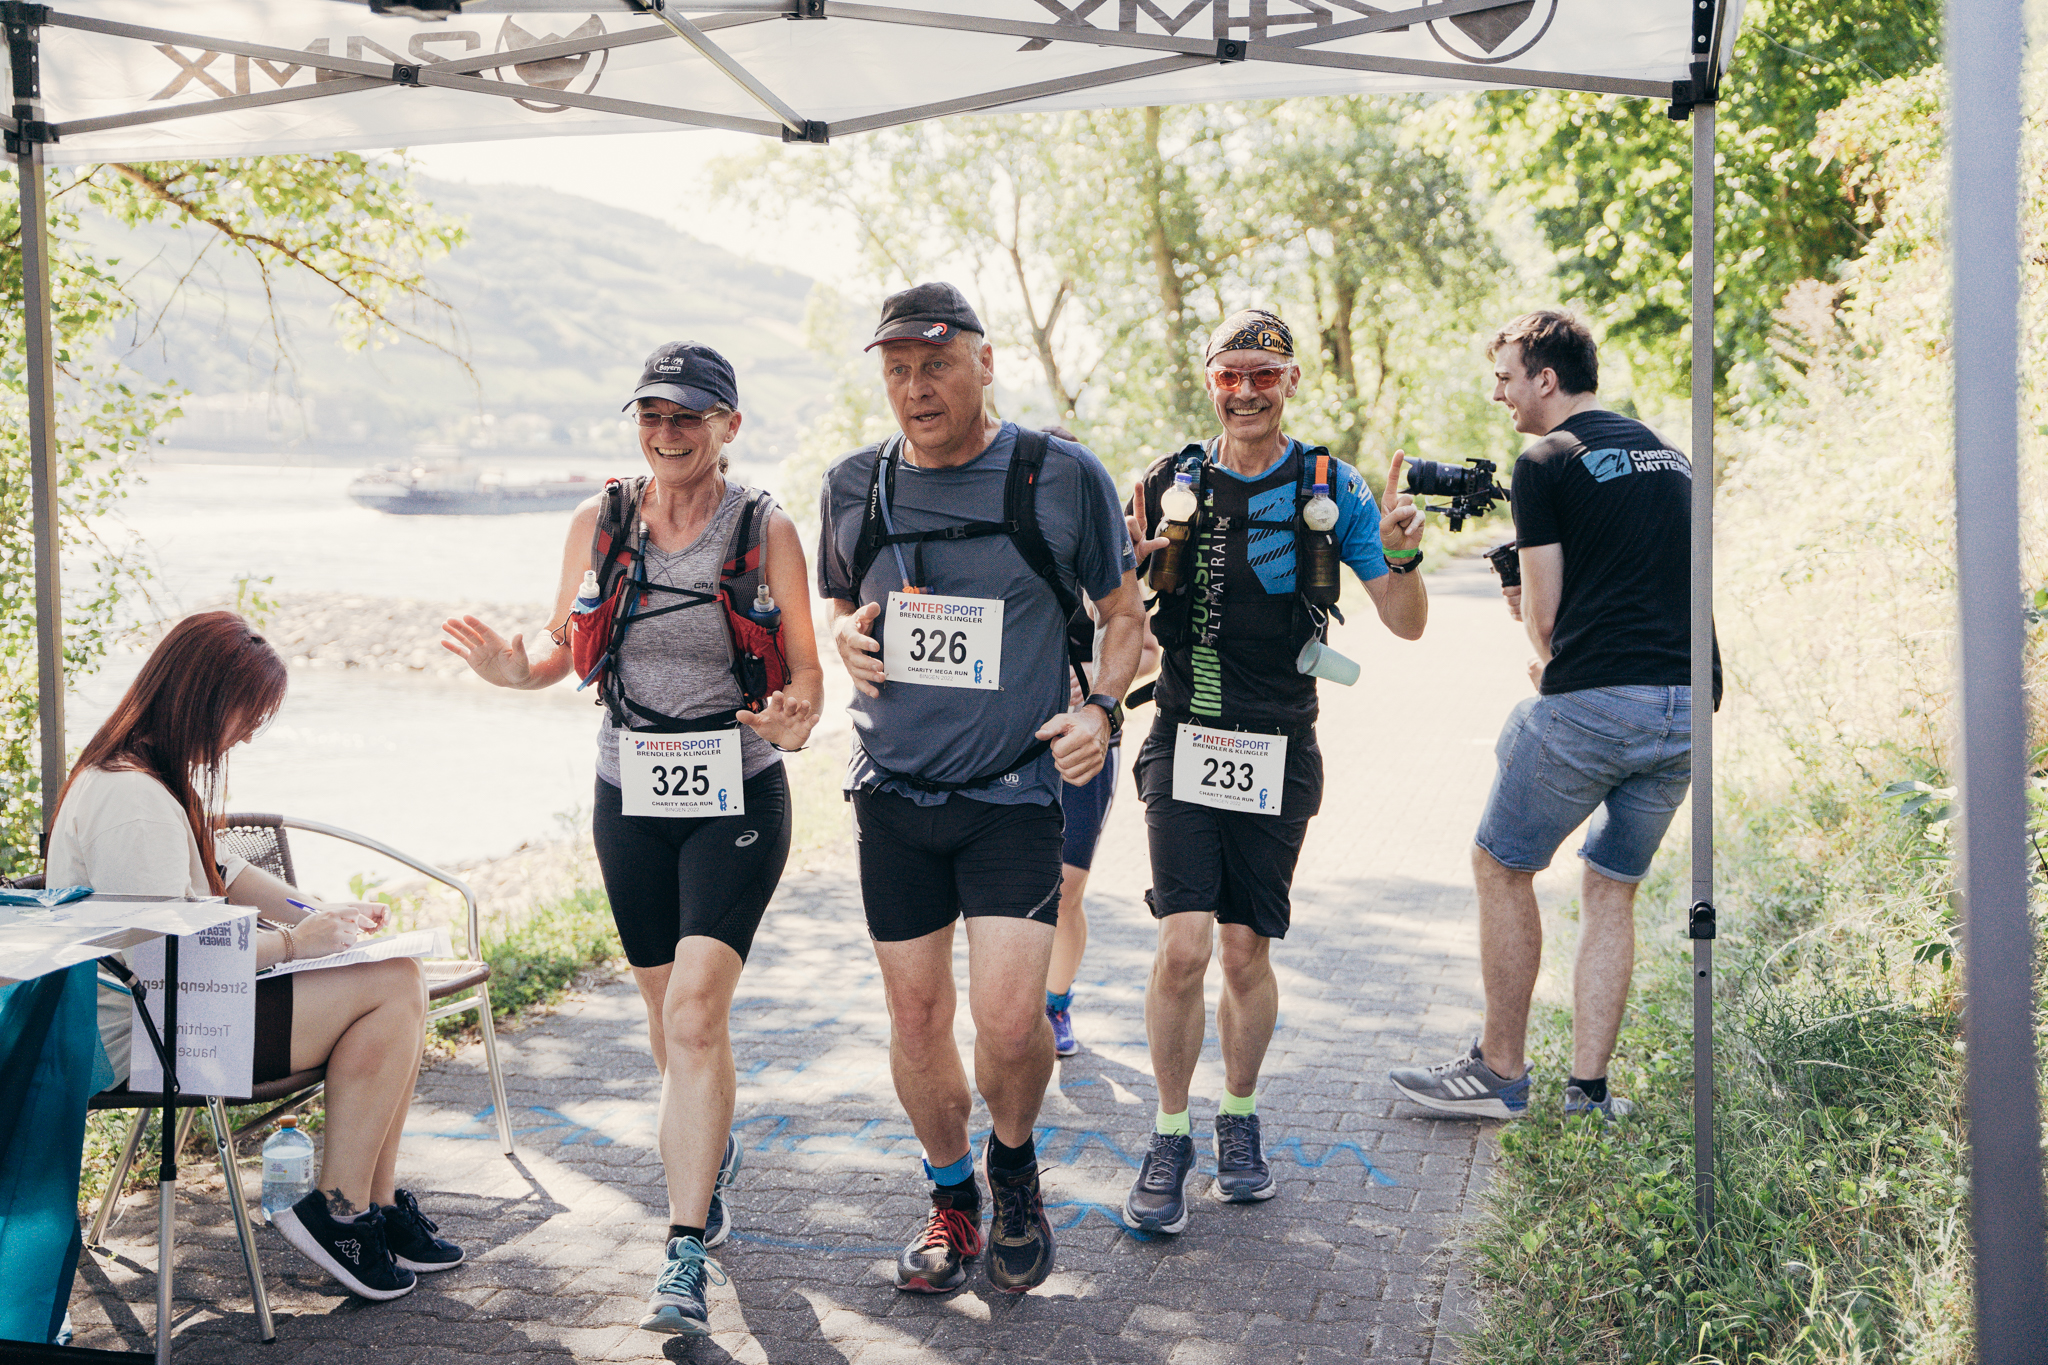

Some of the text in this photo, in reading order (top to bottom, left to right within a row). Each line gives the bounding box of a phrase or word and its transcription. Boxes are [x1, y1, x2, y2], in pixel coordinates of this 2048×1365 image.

[659, 364, 682, 372] Bayern
[908, 601, 985, 617] INTERSPORT
[899, 612, 936, 620] BRENDLER
[944, 615, 983, 623] KLINGLER
[909, 627, 968, 664] 326
[907, 666, 933, 674] CHARITY
[646, 738, 722, 751] INTERSPORT
[1192, 742, 1228, 751] BRENDLER
[1202, 734, 1271, 751] INTERSPORT
[652, 765, 710, 796] 325
[1200, 757, 1254, 792] 233
[1198, 790, 1223, 798] CHARITY
